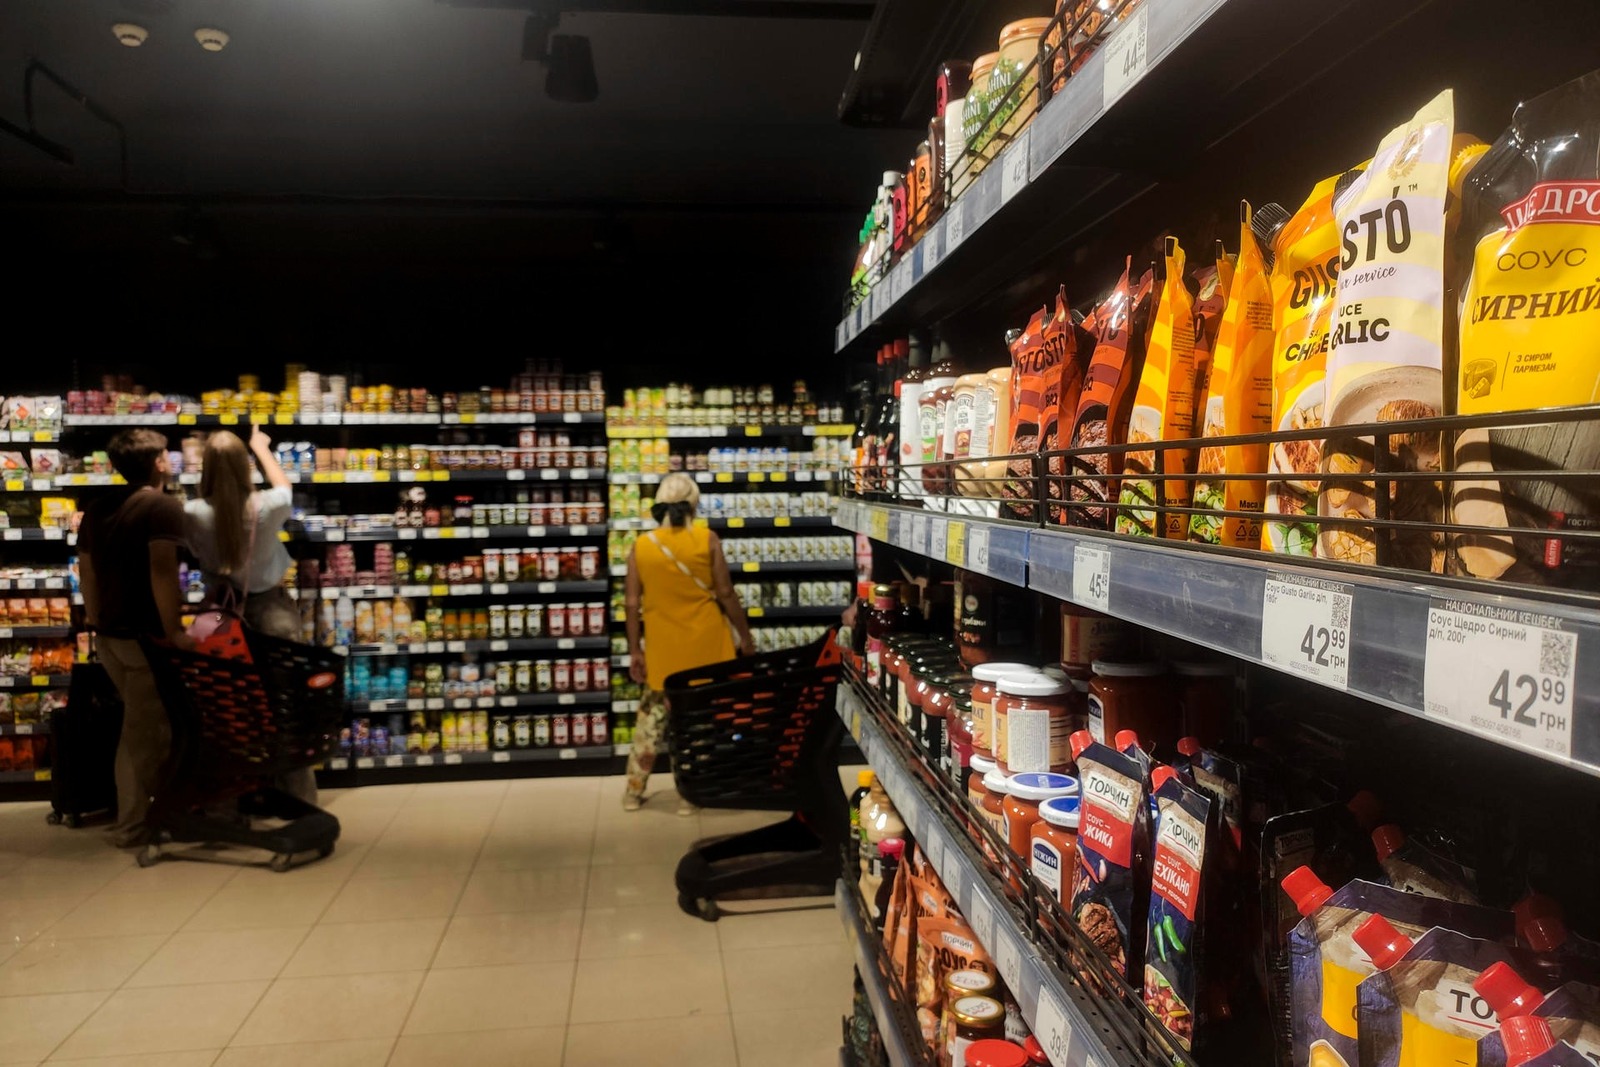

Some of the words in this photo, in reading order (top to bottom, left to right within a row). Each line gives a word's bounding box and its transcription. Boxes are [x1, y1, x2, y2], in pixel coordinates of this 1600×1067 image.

[1497, 247, 1588, 272] СОУС
[1353, 266, 1398, 286] service
[1513, 363, 1556, 374] ПАРМЕЗАН
[1524, 352, 1553, 362] СИРОМ
[1089, 572, 1102, 599] 45
[1266, 582, 1280, 594] Соус
[1281, 585, 1298, 597] Gusto
[1299, 589, 1315, 601] Garlic
[1430, 612, 1452, 627] Соус
[1454, 616, 1486, 636] Щедро
[1488, 622, 1527, 641] Сирний
[1519, 611, 1563, 630] КЕШБЕК
[1301, 624, 1330, 667] 42
[1331, 629, 1346, 649] 99
[1447, 630, 1466, 645] 200г
[1330, 654, 1346, 669] грн
[1488, 669, 1539, 728] 42
[1541, 677, 1566, 705] 99
[1539, 711, 1566, 731] грн
[1089, 776, 1129, 808] ТОРЧИН
[1084, 823, 1114, 849] ЖИКА
[1450, 988, 1500, 1024] ТО
[1050, 1028, 1062, 1058] 39
